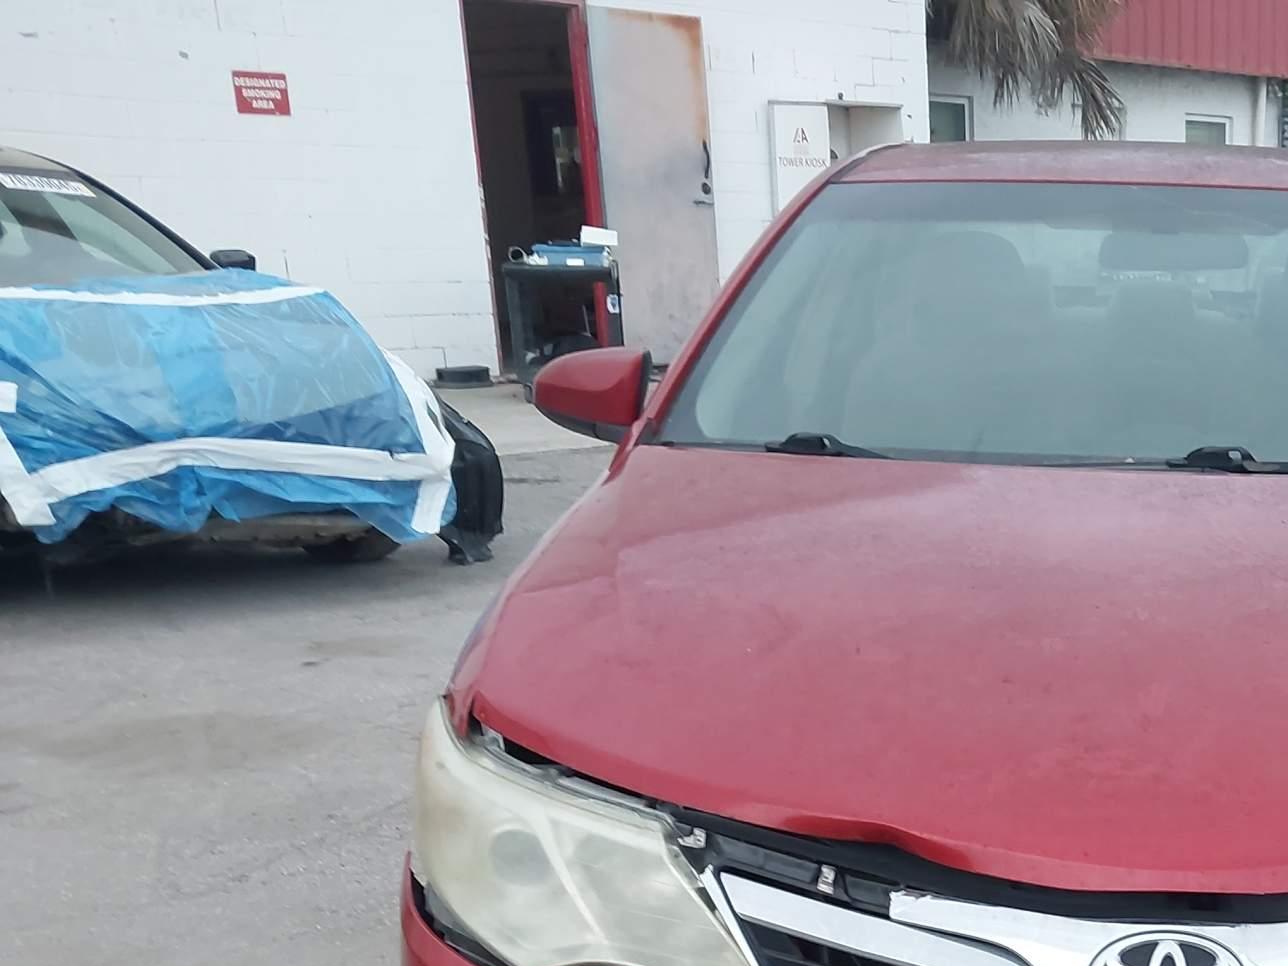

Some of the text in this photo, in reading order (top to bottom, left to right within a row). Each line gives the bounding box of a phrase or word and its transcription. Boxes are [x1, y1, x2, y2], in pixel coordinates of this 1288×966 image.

[233, 77, 286, 89] DESIGNATED
[242, 88, 281, 100] SMOKING
[251, 99, 275, 109] AREA
[778, 156, 828, 169] TOWER KIOSK
